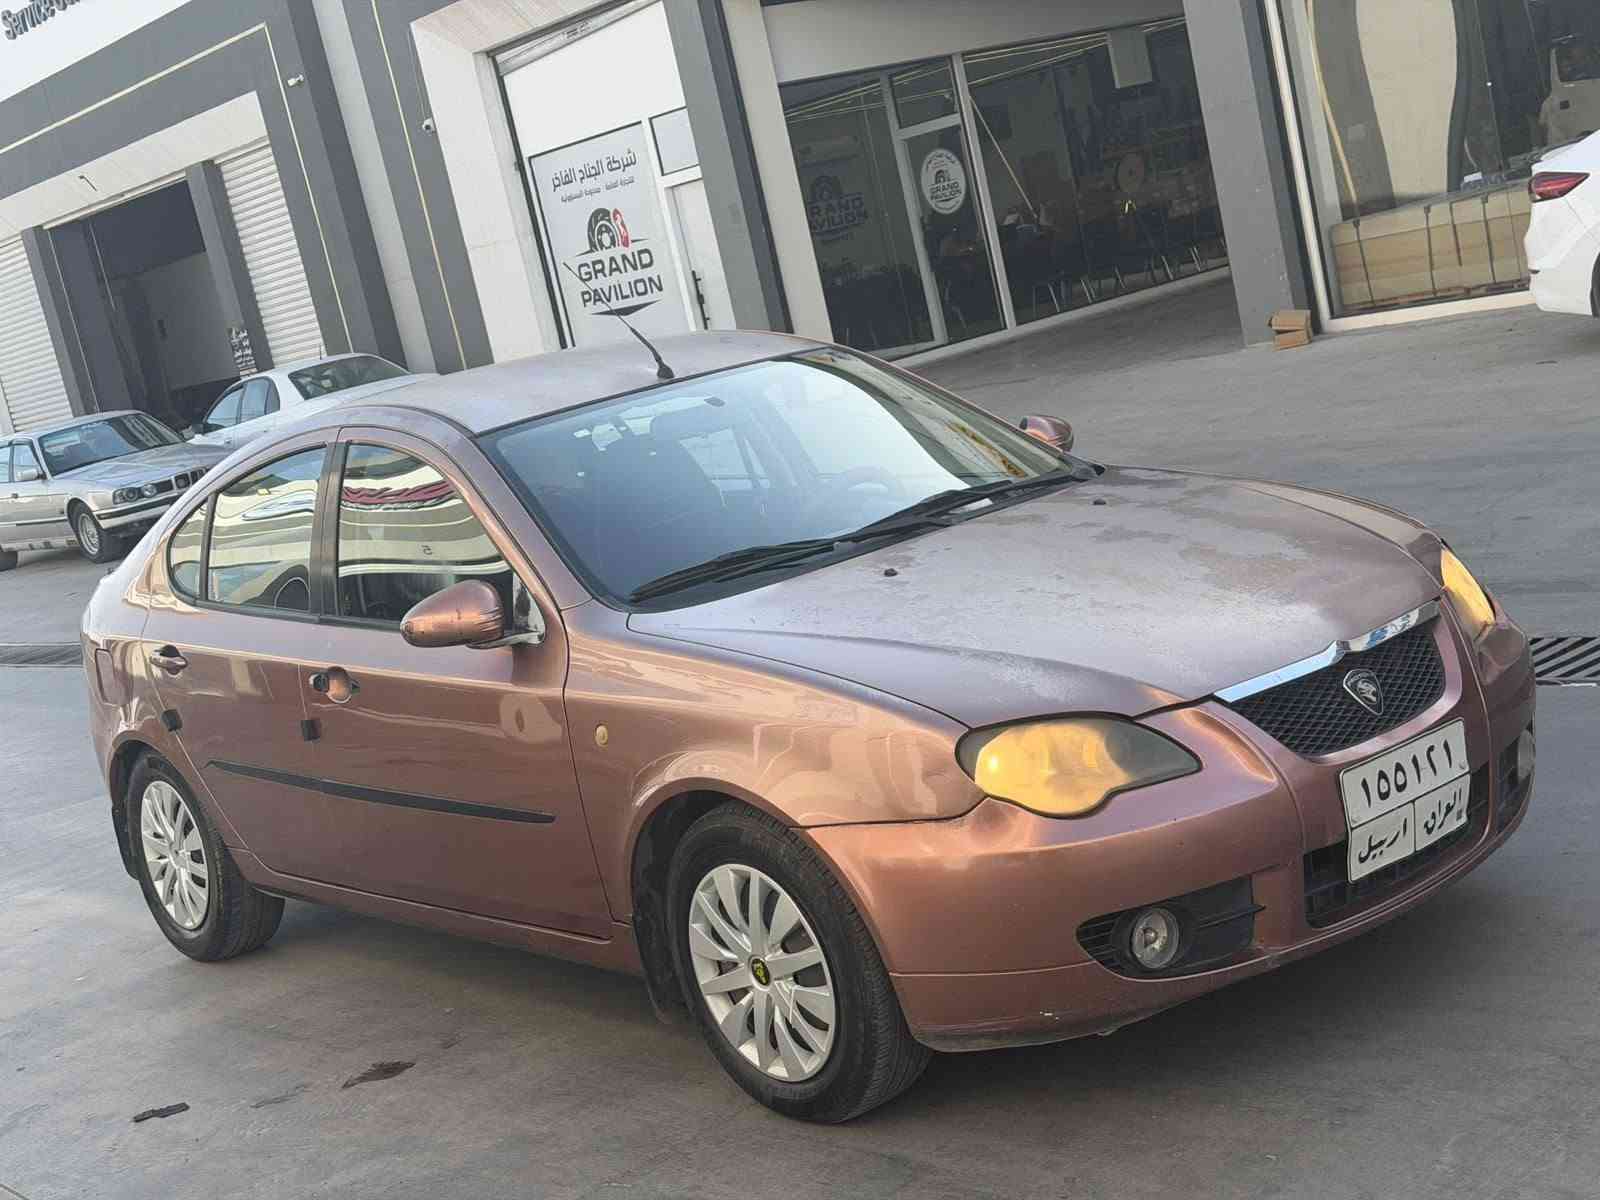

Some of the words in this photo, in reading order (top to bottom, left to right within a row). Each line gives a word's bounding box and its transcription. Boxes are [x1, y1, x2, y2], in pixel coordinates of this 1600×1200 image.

[578, 159, 604, 184] الجناح
[606, 148, 637, 172] شركة
[552, 167, 577, 192] الفاخر
[577, 248, 654, 282] GRAND
[580, 274, 663, 308] PAVILION
[1361, 739, 1453, 808] ١٥٥١٢١
[1358, 817, 1407, 865] اربيل
